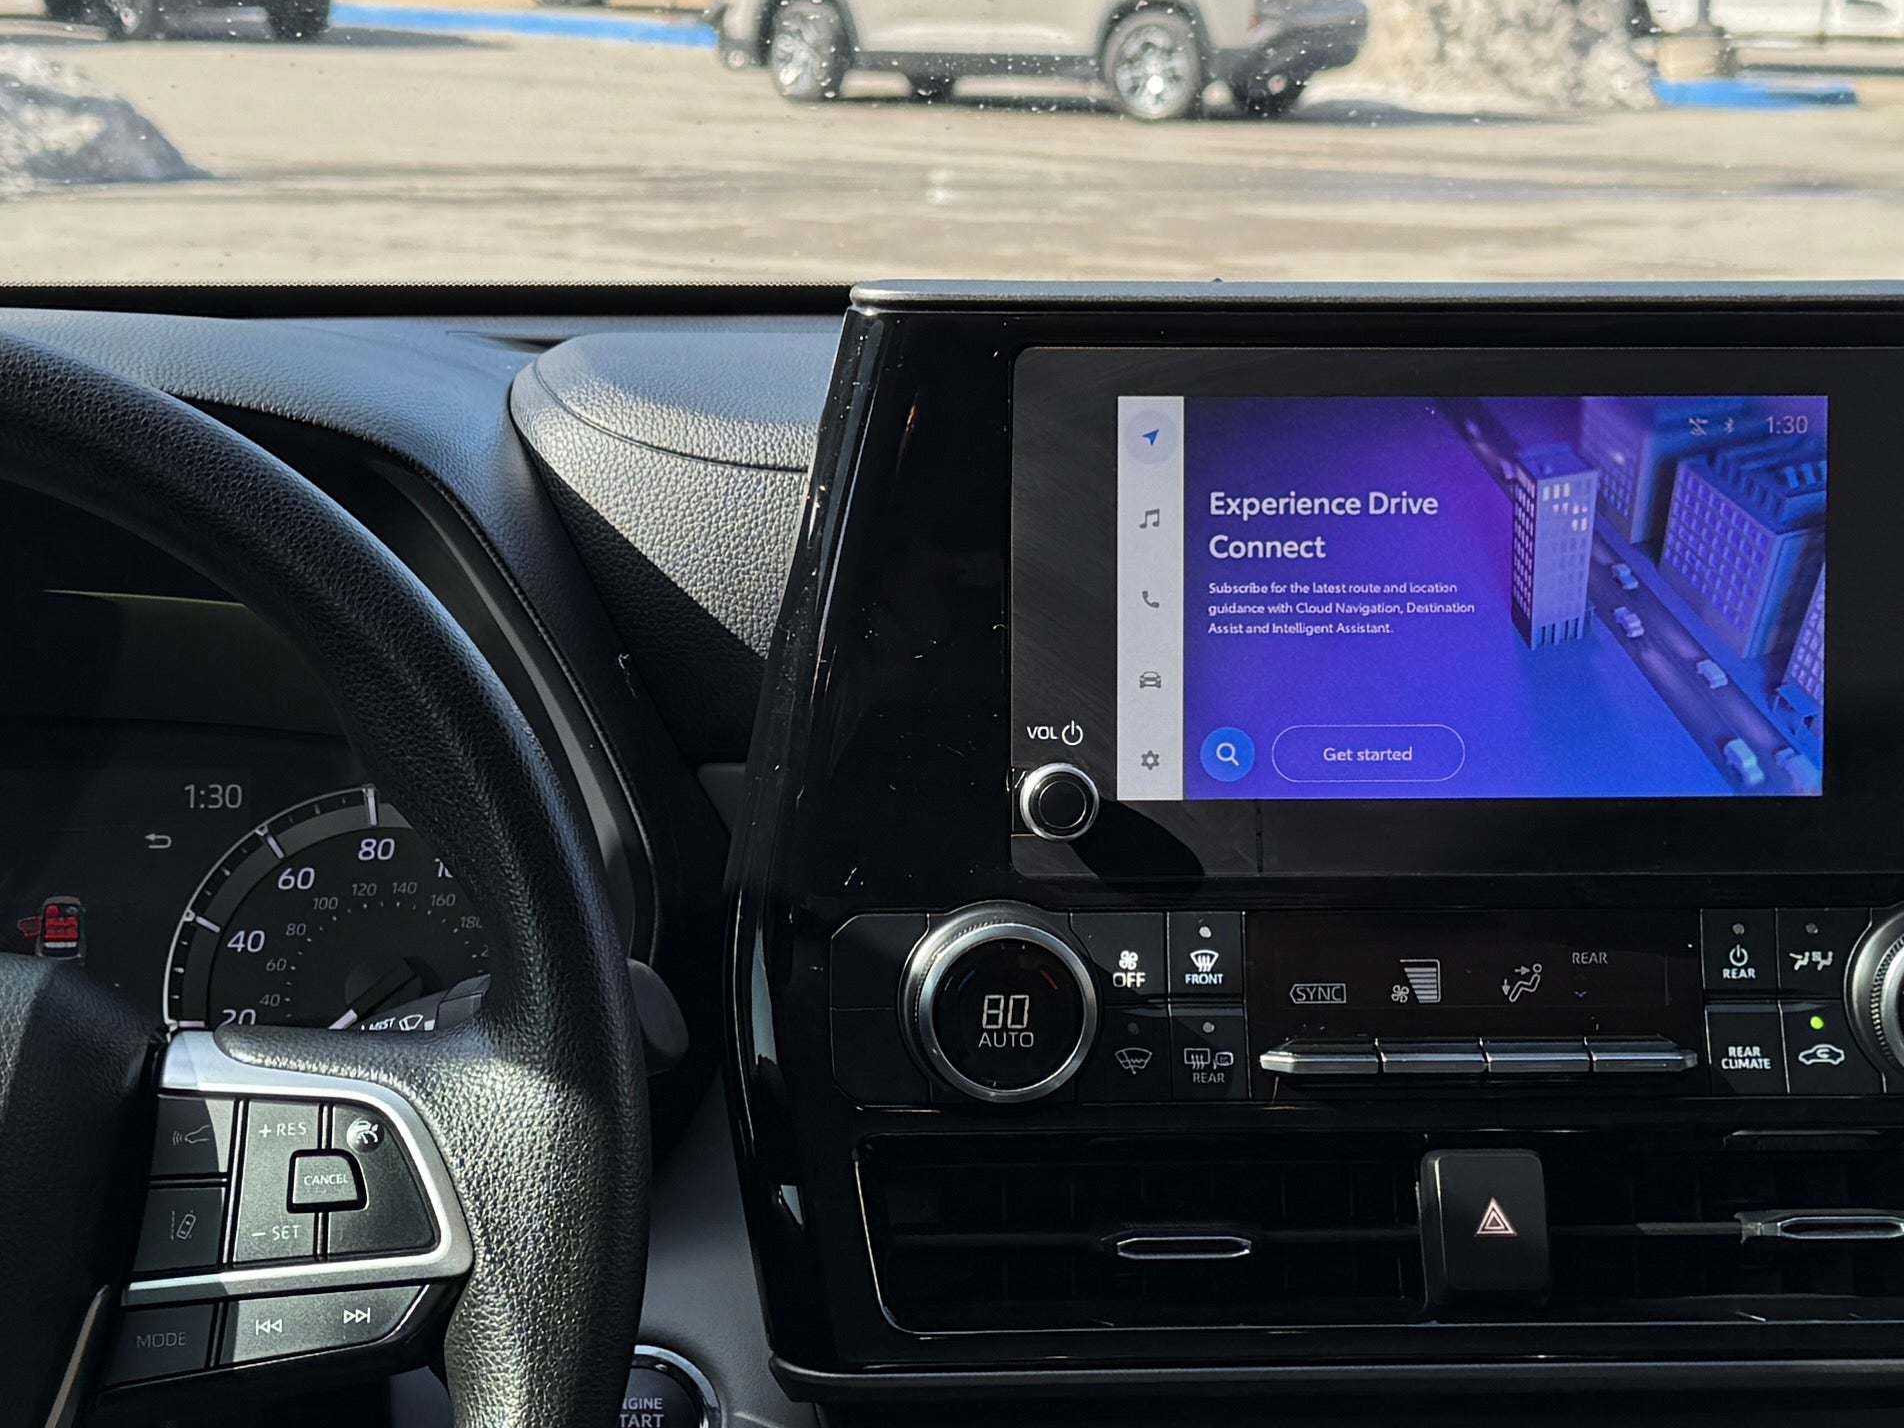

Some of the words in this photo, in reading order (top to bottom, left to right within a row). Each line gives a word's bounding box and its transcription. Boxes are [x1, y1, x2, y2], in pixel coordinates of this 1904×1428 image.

[1764, 414, 1809, 436] 1:30
[1209, 491, 1362, 521] Experience
[1368, 491, 1439, 516] Drive
[1208, 534, 1327, 559] Connect
[1208, 582, 1268, 594] Subscribe
[1270, 582, 1287, 594] for
[1289, 582, 1310, 594] the
[1312, 582, 1346, 594] latest
[1348, 583, 1381, 594] route
[1383, 582, 1406, 594] and
[1409, 582, 1457, 594] location
[1208, 602, 1265, 616] guidance
[1267, 602, 1293, 614] with
[1296, 602, 1332, 614] Cloud
[1335, 602, 1404, 616] Navigation,
[1406, 602, 1475, 614] Destination
[1208, 623, 1244, 635] Assist
[1246, 623, 1270, 634] and
[1272, 622, 1334, 637] Intelligent
[1336, 622, 1394, 634] Assistant.
[1026, 725, 1058, 742] VOL
[1322, 744, 1355, 764] Get
[1359, 744, 1413, 763] started
[184, 783, 243, 810] 1:30
[357, 838, 396, 861] 80
[277, 867, 316, 890] 60
[351, 883, 377, 897] 120
[392, 881, 418, 895] 140
[312, 897, 339, 911] 100
[430, 893, 456, 907] 160
[285, 923, 307, 936] 80
[227, 930, 266, 953] 40
[265, 958, 287, 971] 60
[1571, 952, 1608, 965] REAR
[1112, 972, 1146, 988] OFF
[1184, 973, 1224, 987] FRONT
[1722, 967, 1756, 980] REAR
[259, 993, 281, 1007] 40
[1296, 985, 1343, 1002] SYNC
[222, 1009, 257, 1026] 20
[982, 995, 1029, 1029] 80
[978, 1032, 1034, 1048] AUTO
[1728, 1045, 1762, 1058] REAR
[1721, 1056, 1771, 1070] CLIMATE
[1192, 1072, 1225, 1084] REAR
[276, 1122, 307, 1137] RES
[303, 1173, 349, 1186] CANCEL
[272, 1225, 302, 1241] SET
[136, 1331, 187, 1349] MODE
[622, 1397, 664, 1410] GINE
[619, 1414, 664, 1428] TART
